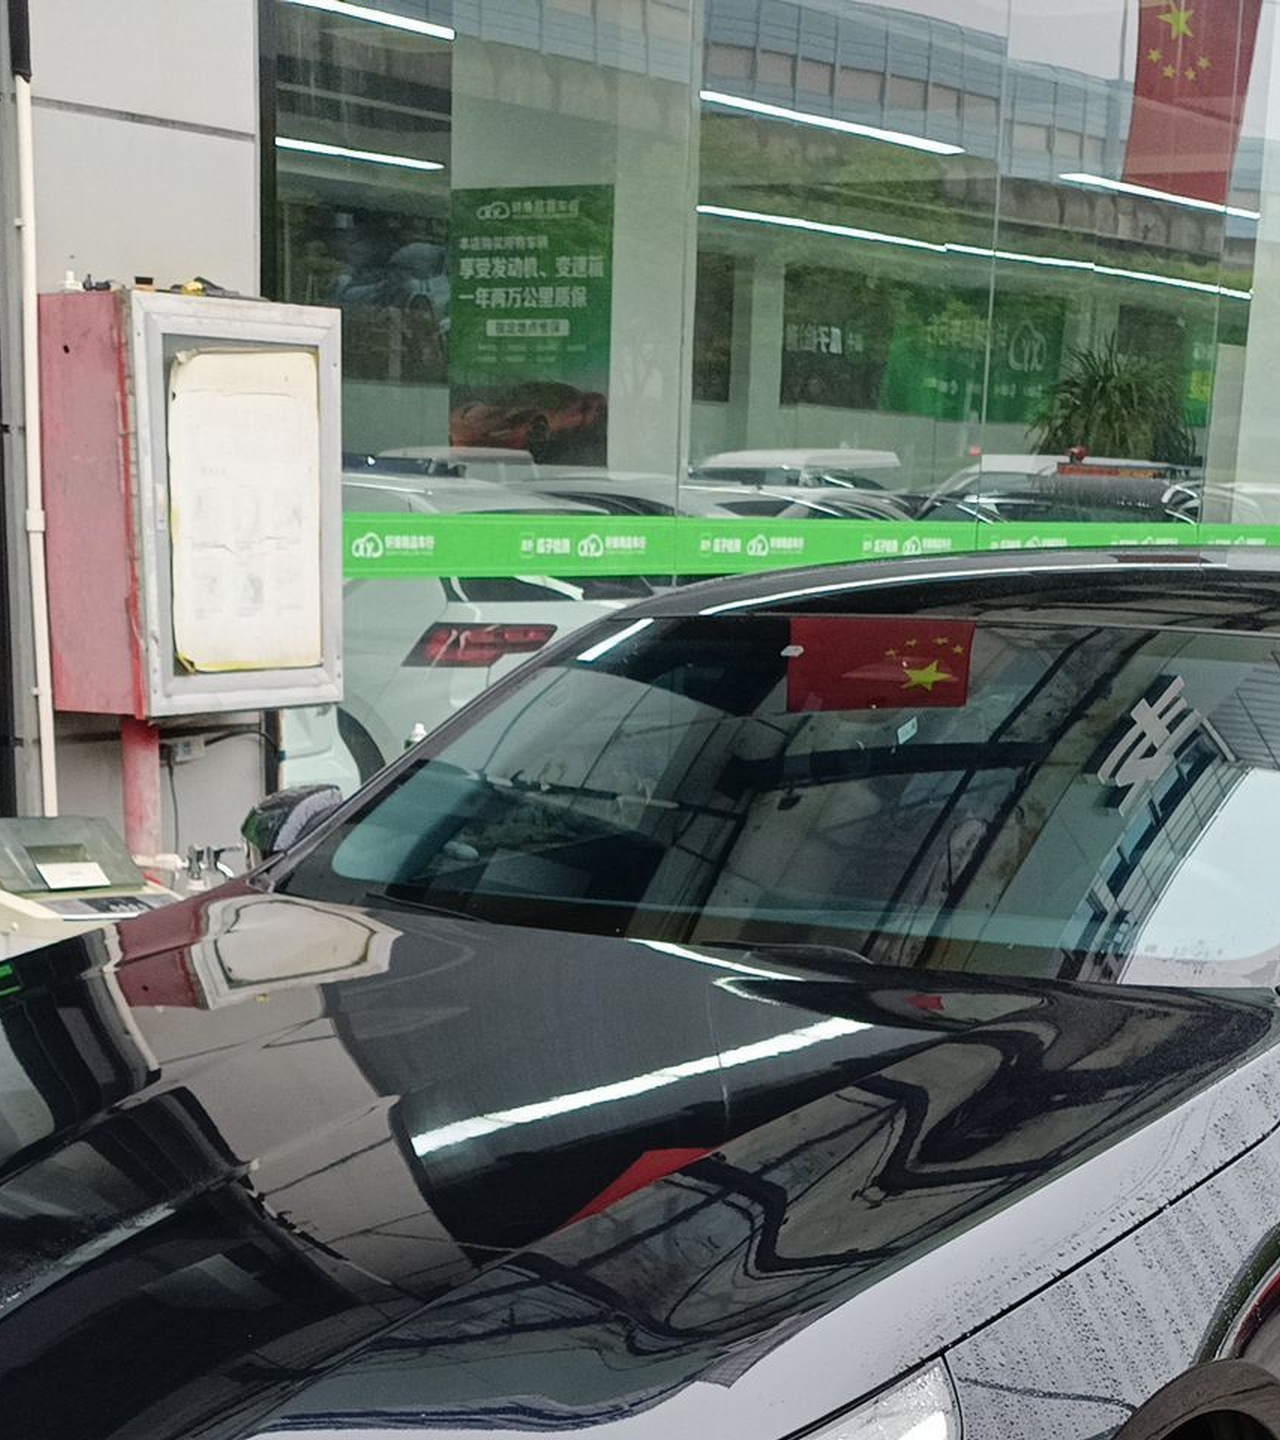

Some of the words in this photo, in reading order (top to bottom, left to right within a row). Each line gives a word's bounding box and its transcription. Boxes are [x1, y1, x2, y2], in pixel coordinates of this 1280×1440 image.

[458, 286, 588, 309] 一年两万公里质保
